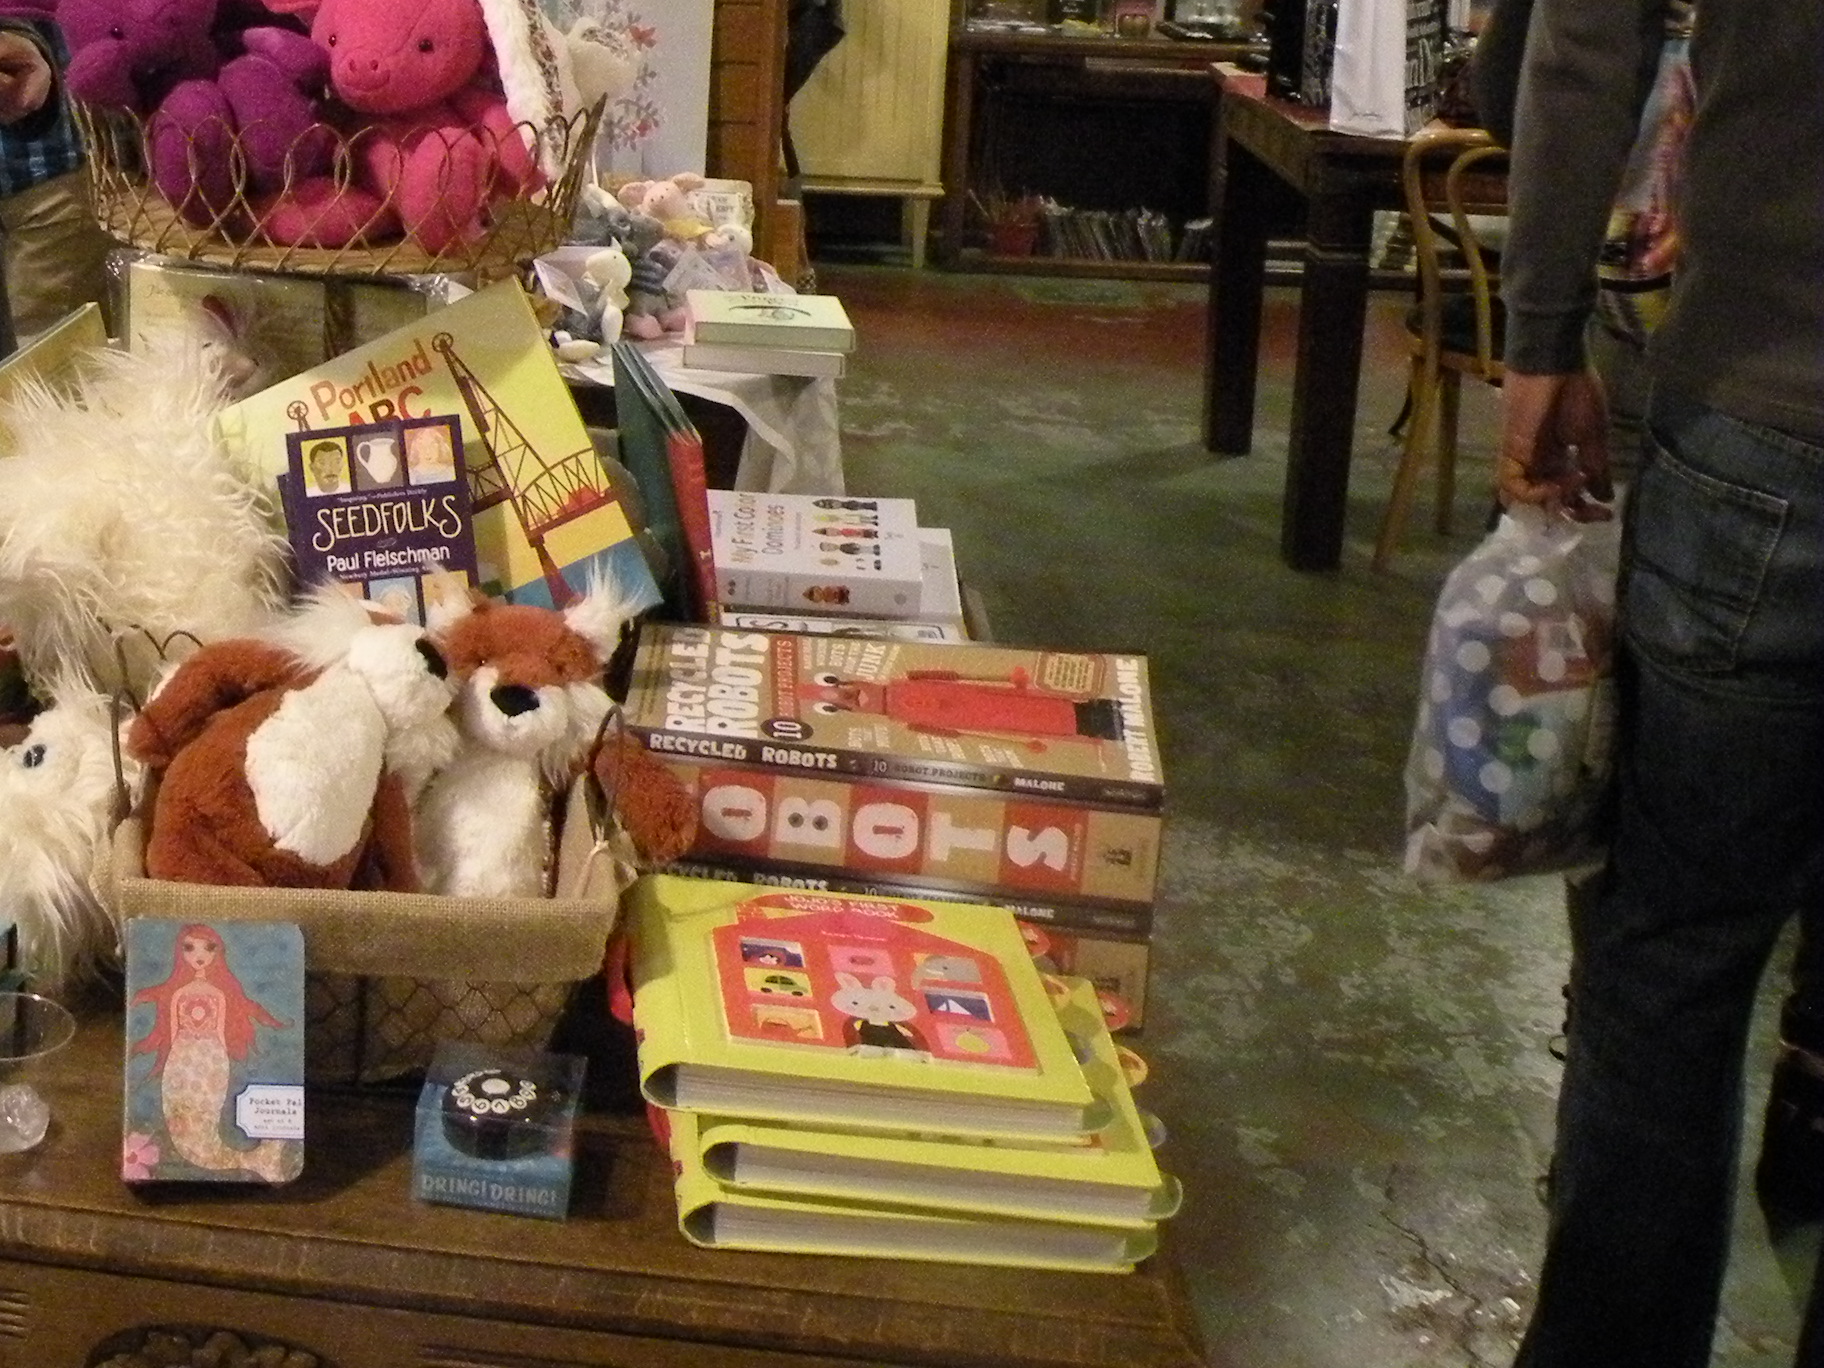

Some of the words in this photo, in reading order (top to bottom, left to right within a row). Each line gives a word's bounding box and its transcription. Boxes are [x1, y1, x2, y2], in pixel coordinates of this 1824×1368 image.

[310, 337, 432, 421] Portland
[312, 495, 462, 551] SEEDFOLKS
[732, 521, 755, 545] First
[761, 504, 785, 555] Dominoes
[326, 552, 360, 572] Paul
[363, 545, 451, 569] Fleischman
[730, 546, 757, 563] My
[664, 628, 712, 731] RECYCLED
[777, 639, 794, 690] PROJECTS
[829, 643, 846, 667] BOTS
[855, 643, 886, 681] JUNK
[705, 631, 770, 739] ROBOTS
[1115, 658, 1145, 727] MALONE
[773, 720, 802, 739] 10
[649, 733, 747, 760] RECYCLED
[761, 746, 838, 769] ROBOTS
[873, 761, 887, 773] 10
[895, 763, 928, 776] ROBOT
[932, 767, 987, 782] PROJECTS
[1014, 777, 1065, 792] MALONE
[1124, 728, 1156, 783] ROBERT
[702, 785, 1069, 872] OBOTS
[666, 863, 738, 882] CYCLED
[791, 902, 844, 913] WORD
[476, 1101, 488, 1110] 6
[494, 1101, 505, 1110] 7
